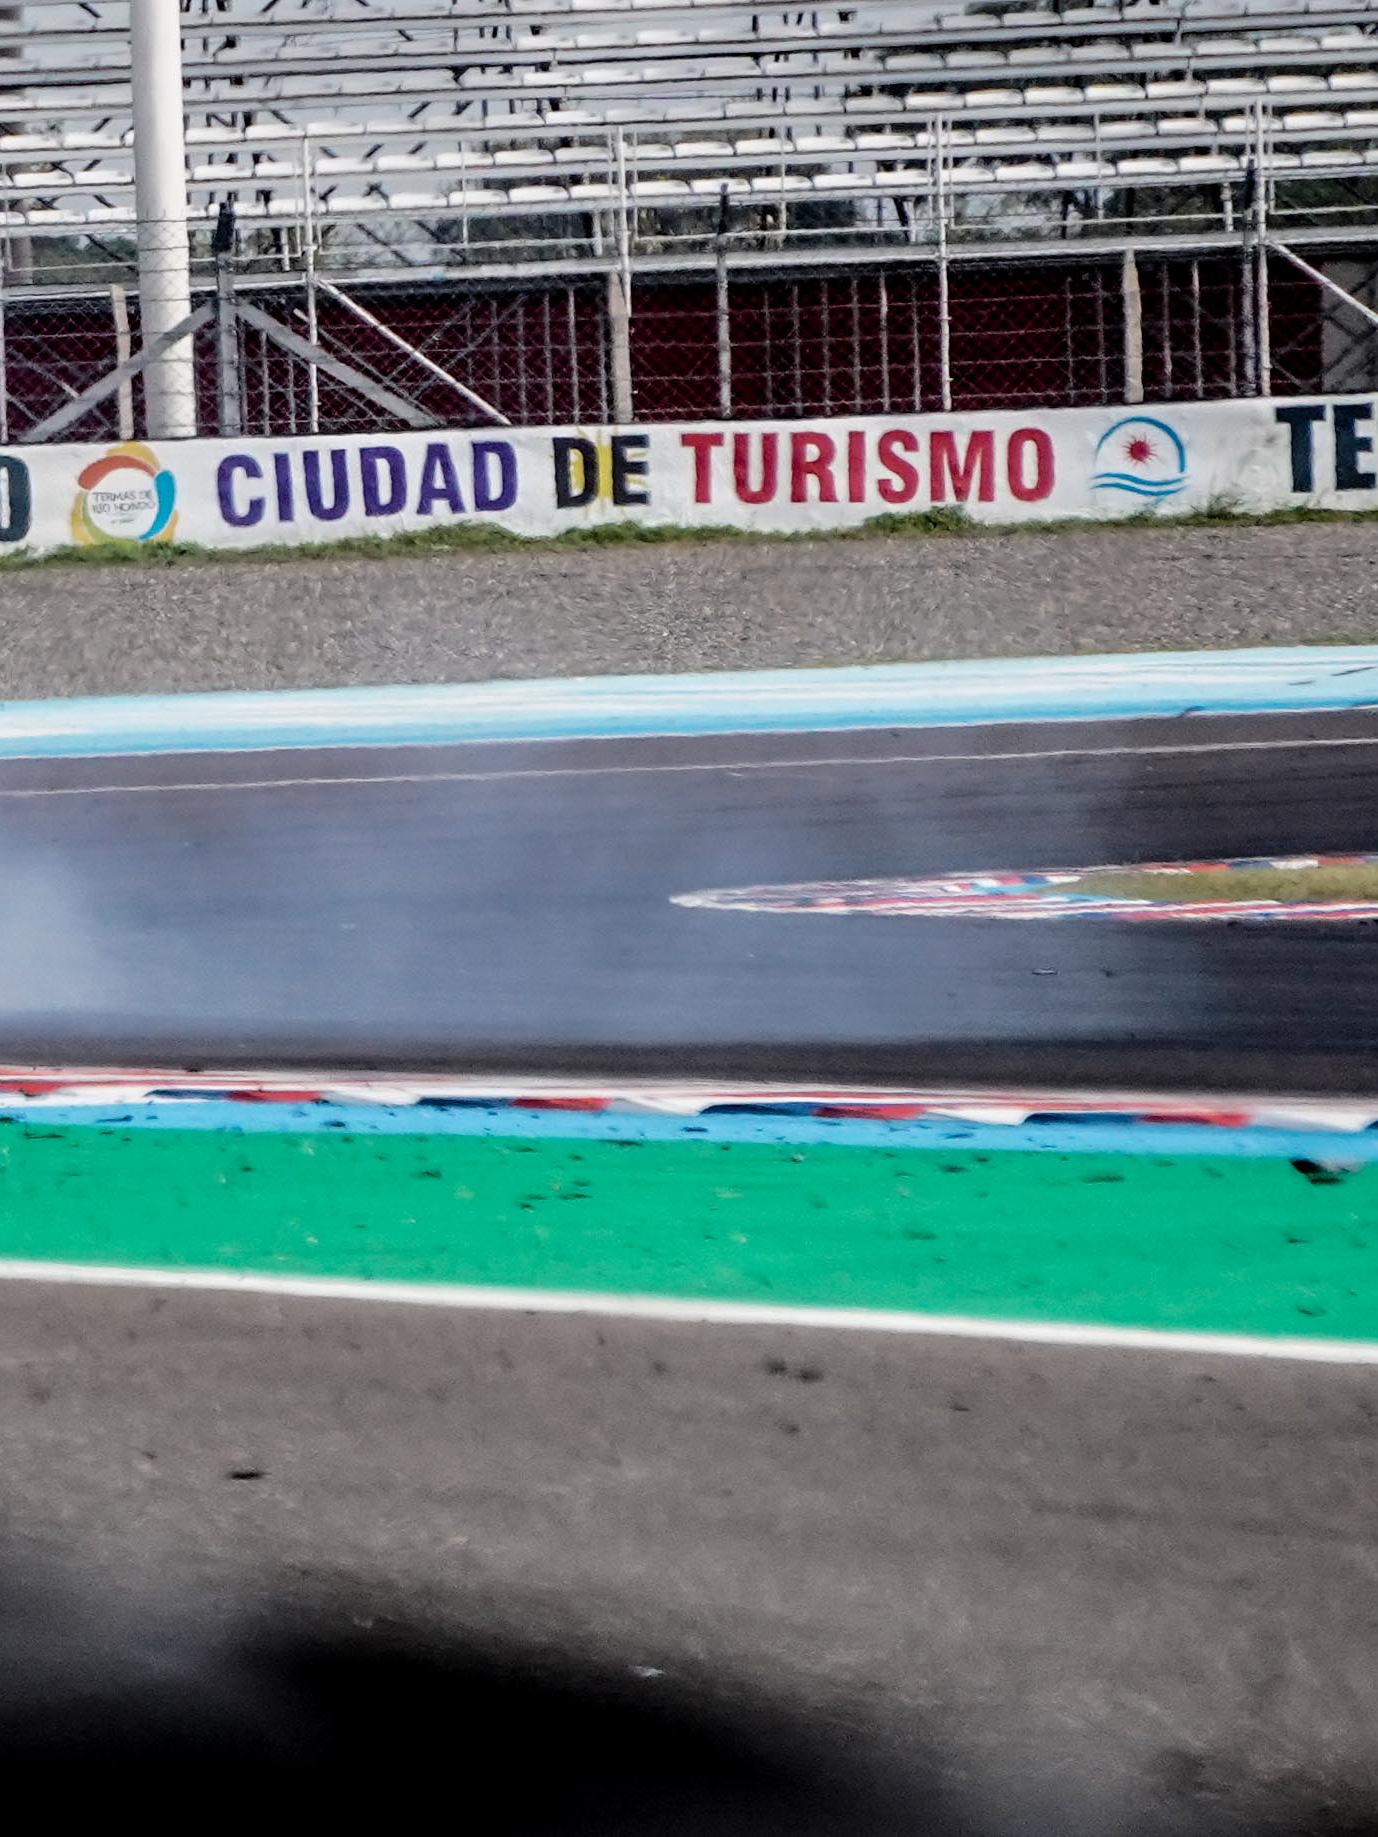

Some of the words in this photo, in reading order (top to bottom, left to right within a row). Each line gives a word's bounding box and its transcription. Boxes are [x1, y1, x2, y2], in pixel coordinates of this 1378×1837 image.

[216, 440, 519, 527] CIUDAD
[552, 433, 651, 510] DE
[681, 426, 1055, 504] TURISMO
